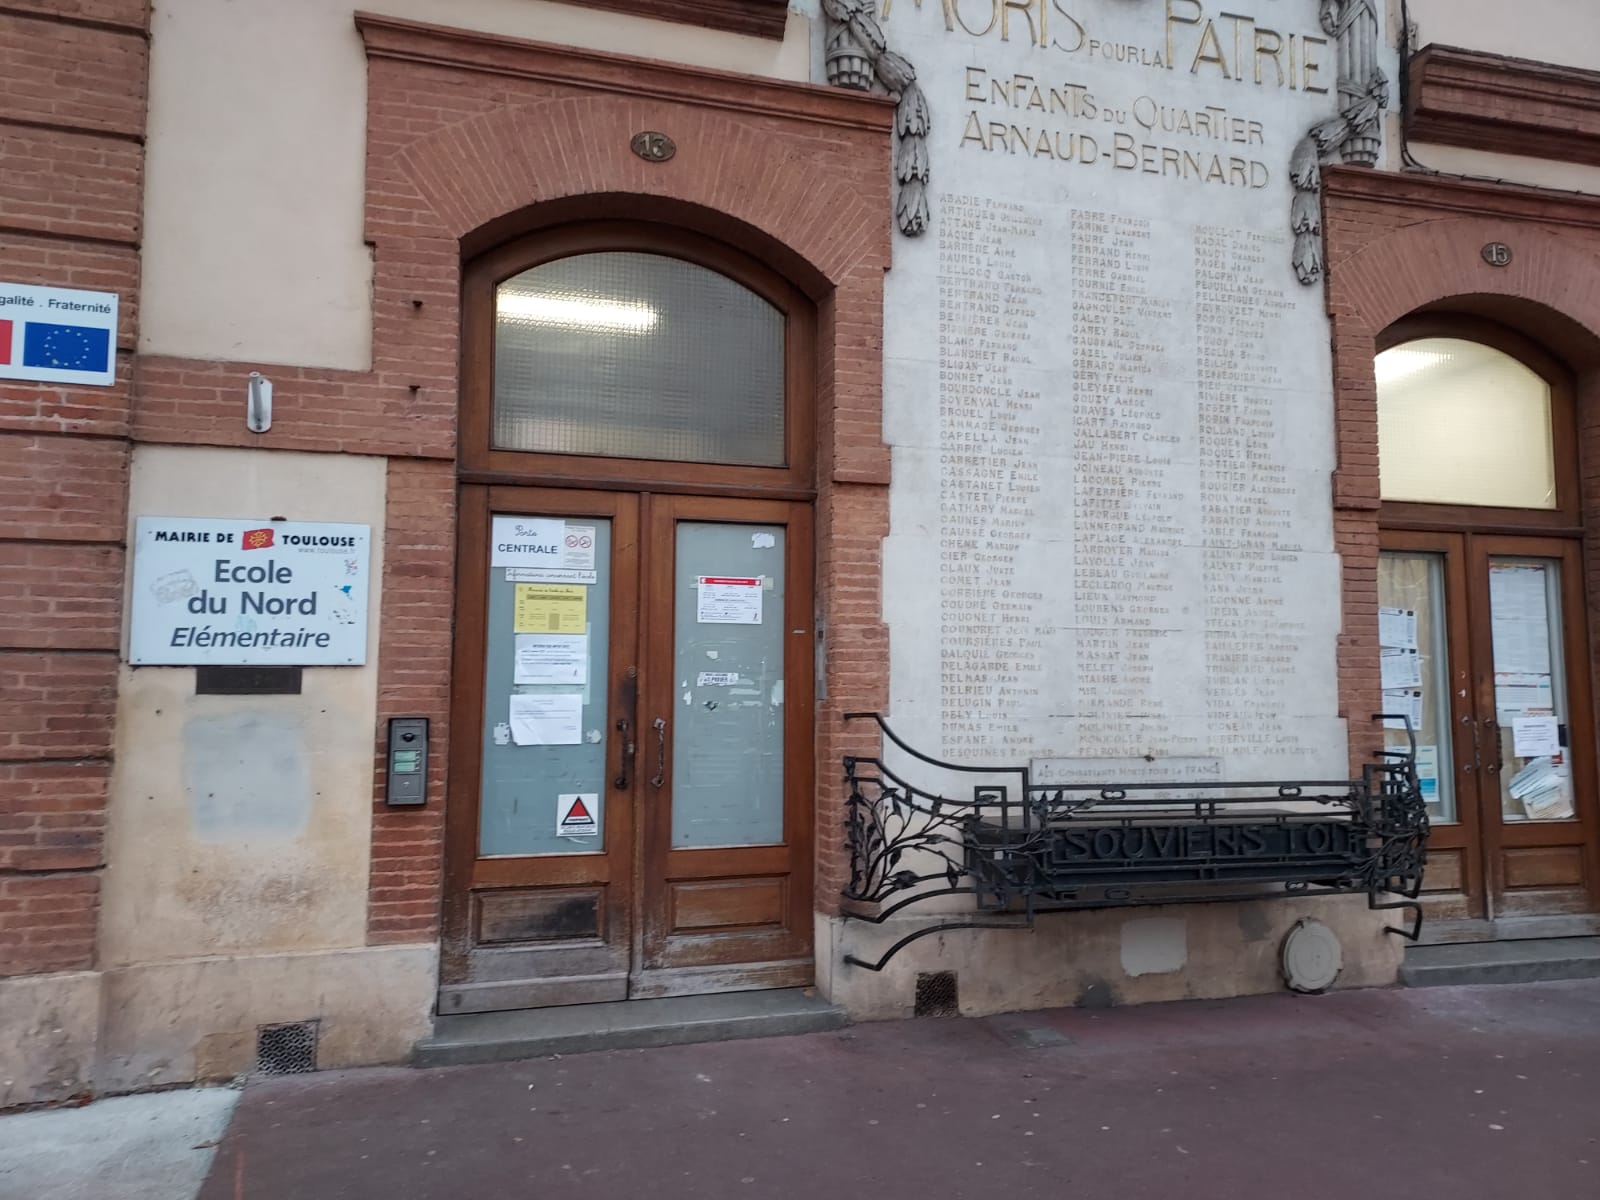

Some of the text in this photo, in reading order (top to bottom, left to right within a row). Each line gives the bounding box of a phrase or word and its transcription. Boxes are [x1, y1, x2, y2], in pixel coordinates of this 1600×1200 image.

[1165, 0, 1328, 93] PATRIE
[967, 66, 1264, 144] ENFANTS DU QUARTIER
[961, 110, 1270, 189] ARNAUD-BERNARD
[48, 299, 111, 313] Fraternité
[155, 531, 355, 547] MAIRIE DE TOULOUSE
[498, 543, 559, 555] CENTRALE
[214, 559, 293, 584] Ecole
[188, 589, 317, 616] du Nord
[170, 625, 330, 648] Elémentaire
[1064, 822, 1339, 859] SOUVIENS TOI
